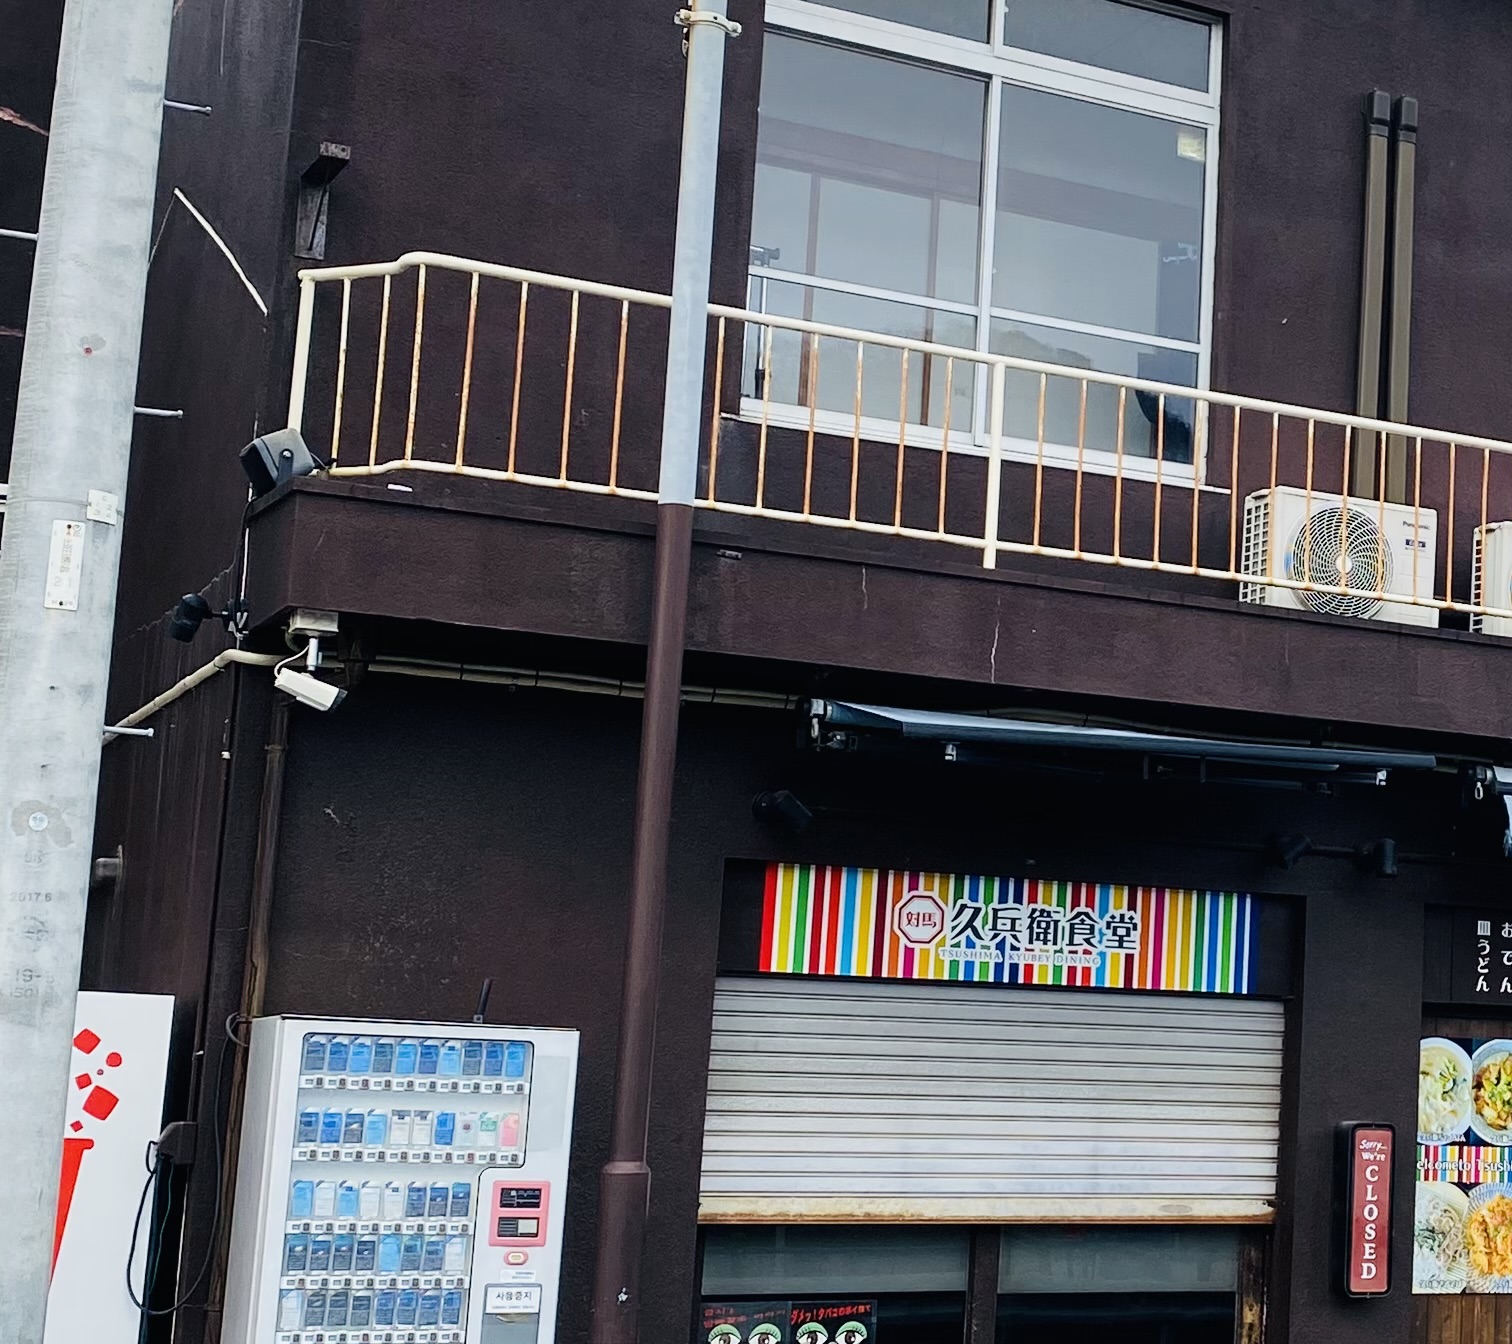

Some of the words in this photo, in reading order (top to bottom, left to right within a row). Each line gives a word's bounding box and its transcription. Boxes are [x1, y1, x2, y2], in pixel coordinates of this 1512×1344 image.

[905, 911, 938, 929] 対馬
[950, 903, 1138, 951] 久兵衛食堂
[940, 949, 1002, 961] TSUSHIMA
[1008, 952, 1052, 963] KYUBEY
[1055, 953, 1100, 965] DINING
[1476, 920, 1491, 993] 皿うどん
[1361, 1151, 1386, 1162] We're
[1360, 1165, 1380, 1280] CLOSED
[496, 1291, 532, 1301] 사용중지
